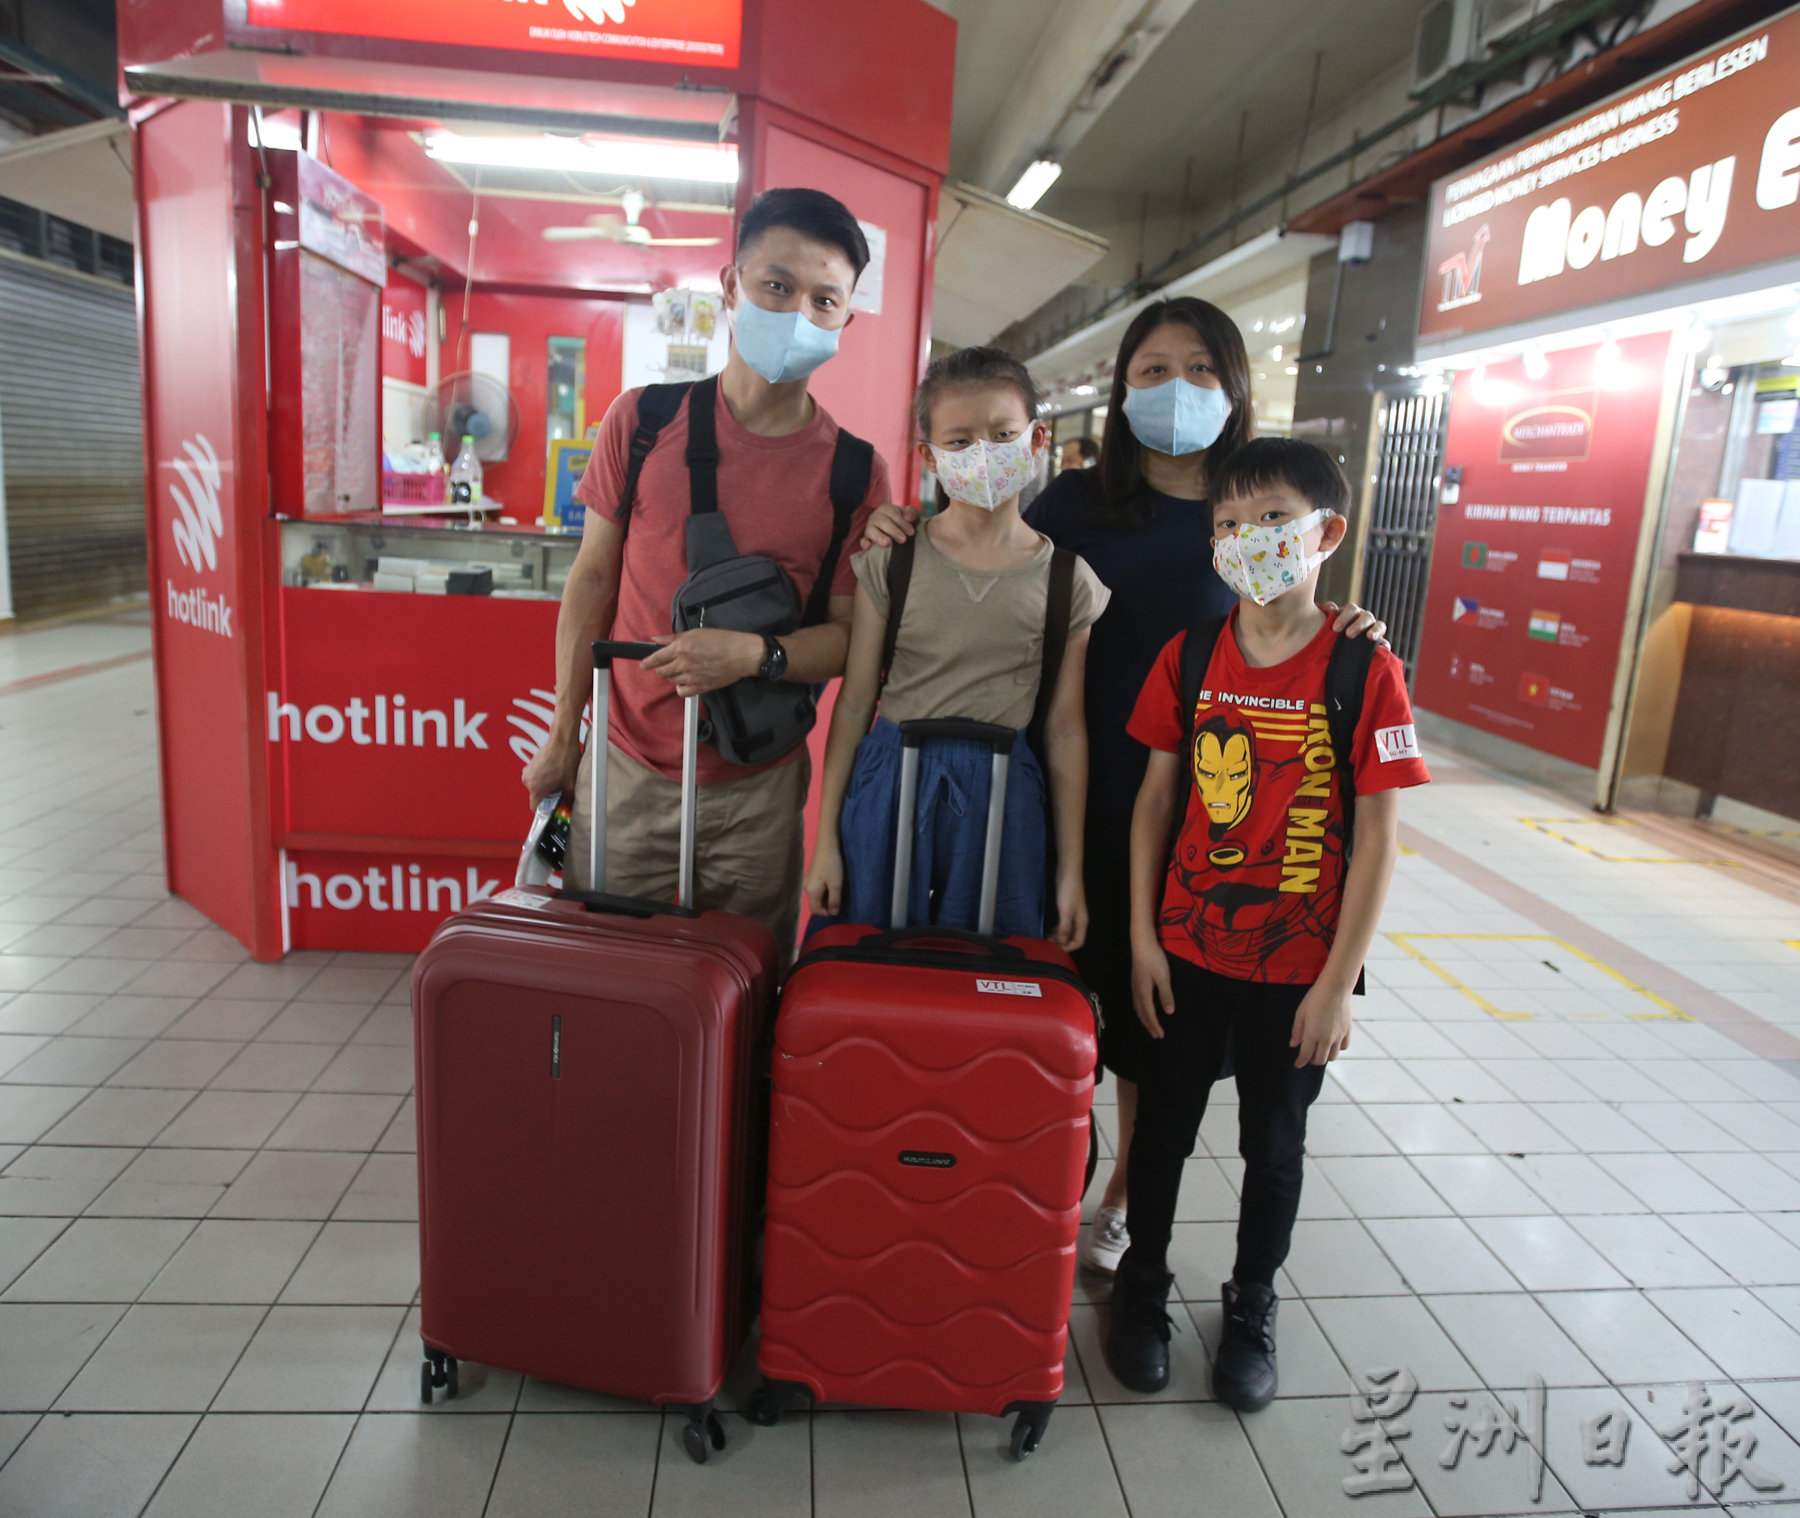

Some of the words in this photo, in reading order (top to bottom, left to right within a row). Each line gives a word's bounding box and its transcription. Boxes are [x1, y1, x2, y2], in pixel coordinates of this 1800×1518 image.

[1619, 80, 1673, 125] WANG
[1672, 34, 1769, 101] BERLESEN
[1494, 169, 1540, 207] MONEY
[1537, 142, 1601, 188] SERVICES
[1600, 108, 1680, 162] BUSINESS
[1518, 155, 1736, 286] Money
[1756, 106, 1800, 211] E
[1465, 503, 1507, 521] KIRIMAN
[1508, 505, 1541, 523] WANG
[1542, 506, 1611, 527] TERPANTAS
[167, 579, 232, 638] hotlink
[267, 691, 489, 749] hotlink
[1218, 691, 1305, 710] INVINCIBLE
[1296, 703, 1336, 797] IRON
[1379, 730, 1412, 751] VTL
[1278, 807, 1329, 893] MAN
[287, 861, 500, 912] hotlink
[981, 981, 1012, 991] VTL
